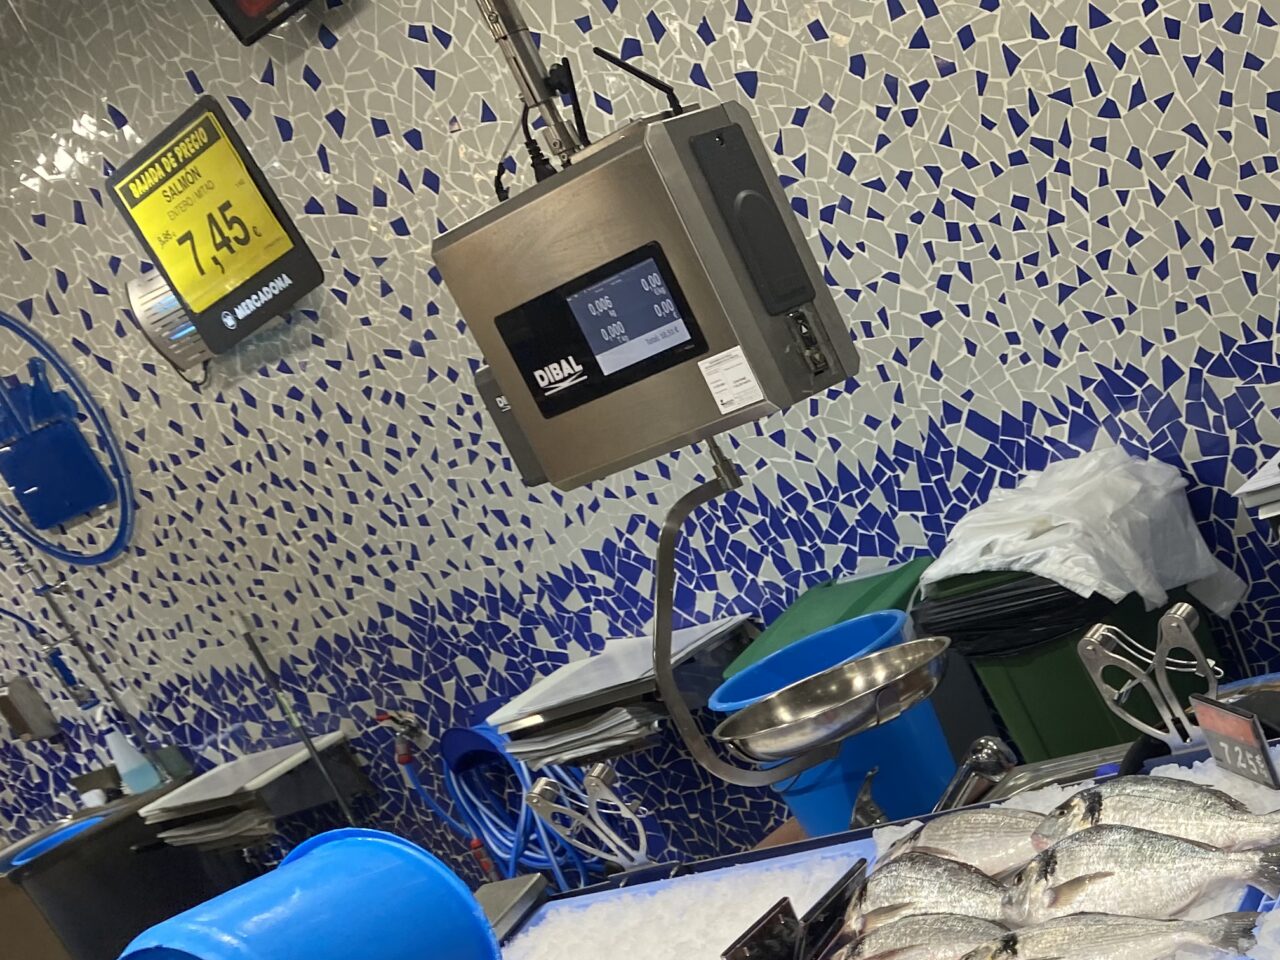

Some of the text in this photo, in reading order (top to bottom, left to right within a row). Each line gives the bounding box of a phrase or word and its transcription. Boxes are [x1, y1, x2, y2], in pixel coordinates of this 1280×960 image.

[129, 127, 209, 199] BAJADA DE PRECIO
[162, 165, 202, 203] SALMÓN
[177, 200, 251, 276] 7,45
[233, 273, 293, 320] MERCADONA
[533, 356, 583, 388] DIBAL
